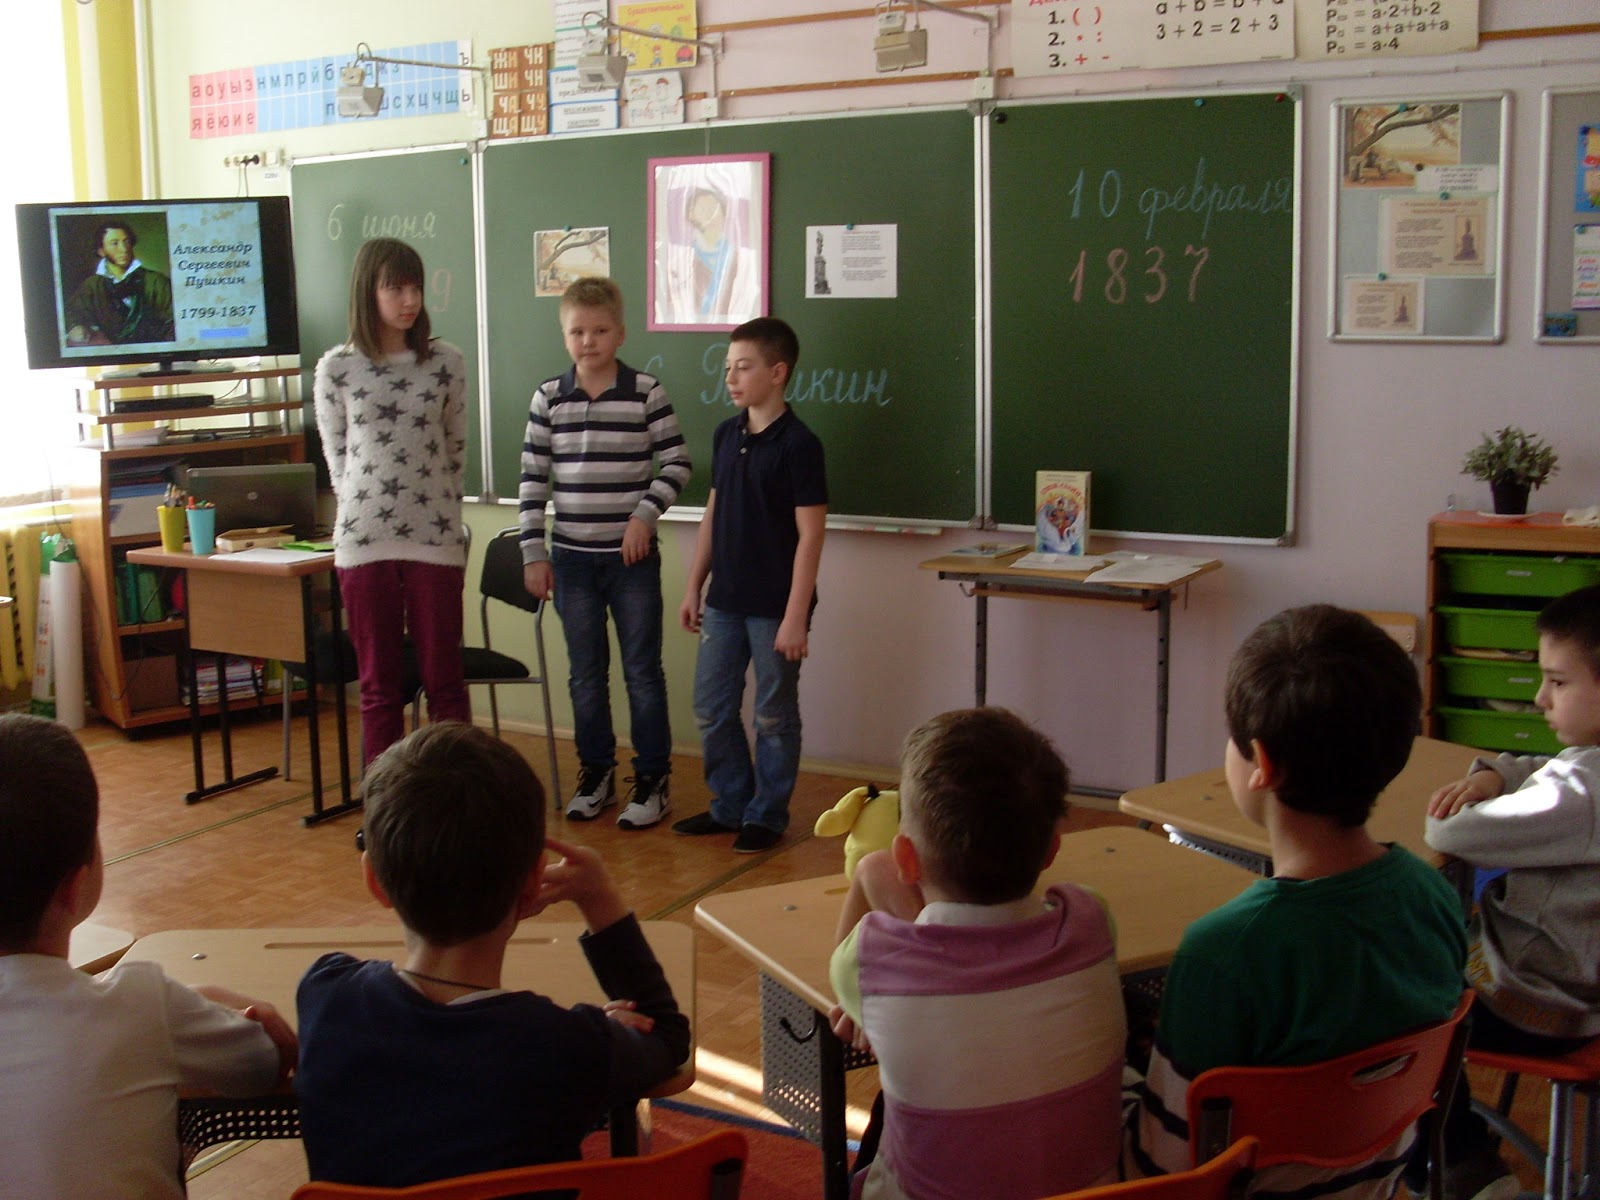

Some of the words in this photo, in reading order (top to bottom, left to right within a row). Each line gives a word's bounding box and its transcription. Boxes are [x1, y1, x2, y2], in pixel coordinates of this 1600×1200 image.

[1048, 10, 1065, 25] 1.
[1156, 23, 1167, 40] 3
[1173, 24, 1186, 38] +
[1192, 20, 1203, 37] 2
[1210, 23, 1223, 32] =
[1230, 17, 1241, 34] 2
[1248, 18, 1261, 32] +
[1269, 14, 1279, 31] 3
[1048, 31, 1066, 47] 2.
[493, 51, 519, 70] ЖИ
[1048, 53, 1067, 68] 3.
[493, 71, 519, 90] ШИ
[523, 68, 544, 87] ЧН
[499, 95, 519, 114] ЧА
[526, 93, 546, 111] ЧУ
[492, 115, 519, 137] ЩА
[520, 114, 546, 135] ЩУ
[1068, 167, 1122, 220] 10
[1138, 157, 1292, 241] февраля
[327, 203, 345, 241] 6
[362, 211, 438, 239] июня
[173, 240, 253, 256] Александр
[177, 258, 252, 274] Сергеевич
[1068, 243, 1211, 304] 1837
[184, 274, 247, 290] Пушкин
[180, 304, 257, 320] 1799-1837
